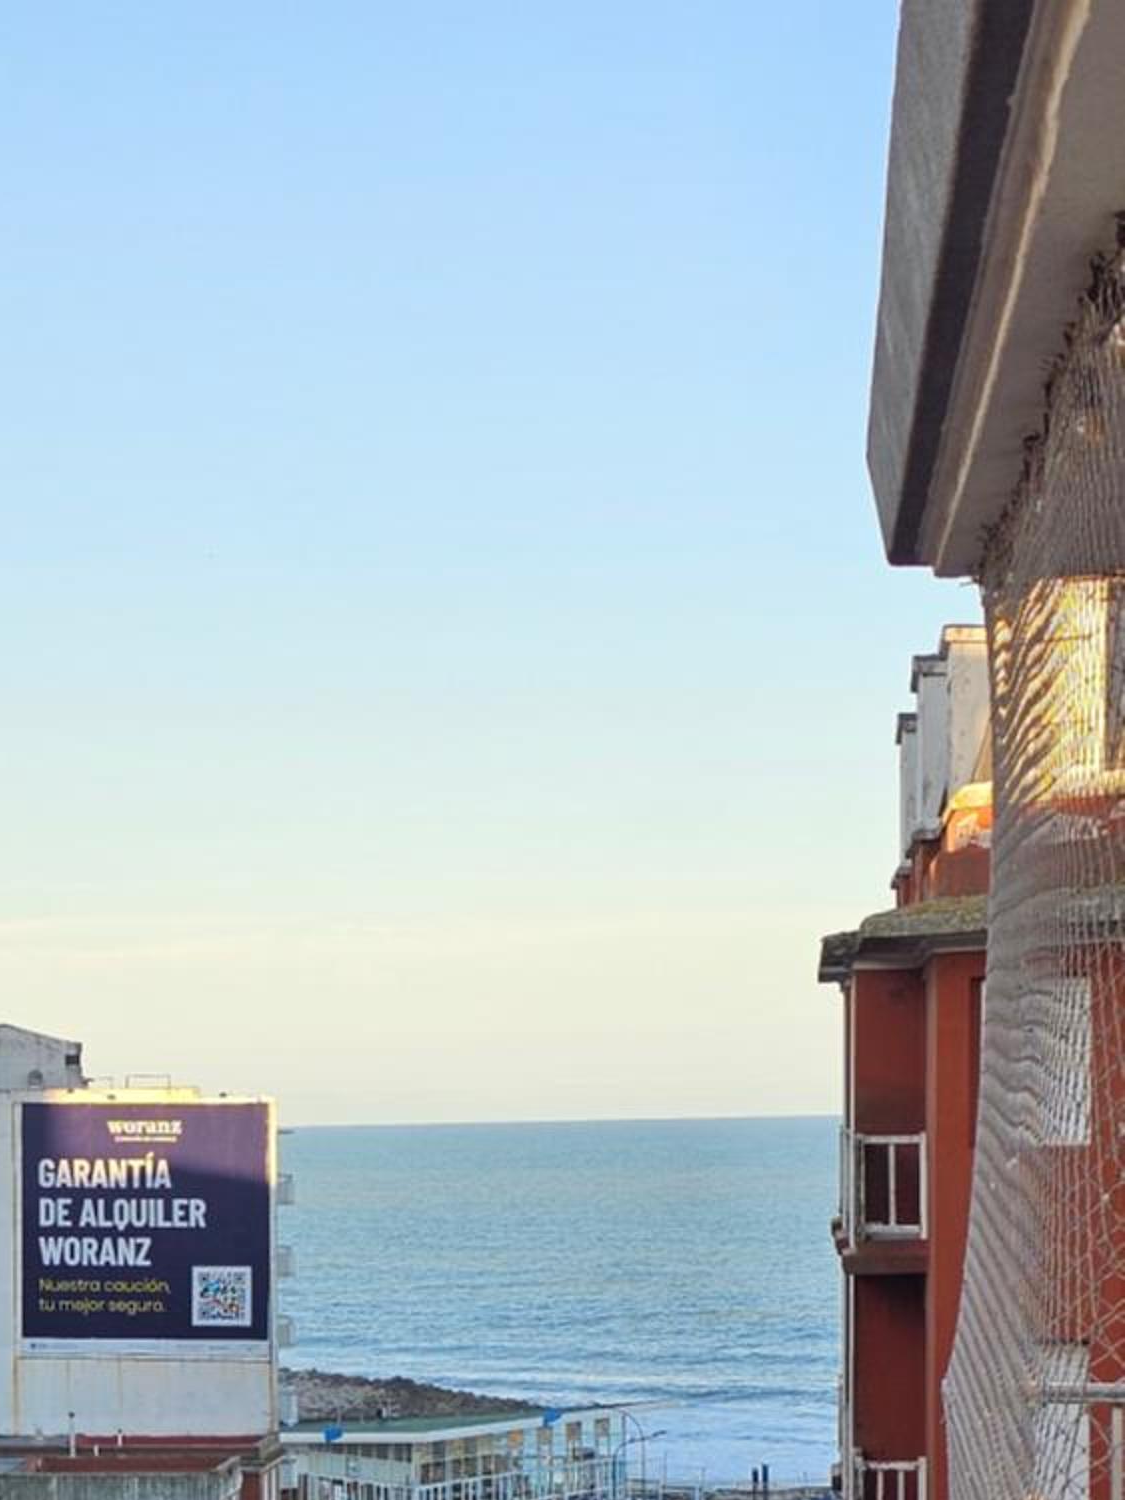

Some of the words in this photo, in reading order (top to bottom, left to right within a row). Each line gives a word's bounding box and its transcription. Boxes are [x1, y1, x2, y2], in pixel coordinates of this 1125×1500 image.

[107, 1120, 182, 1135] woranz
[38, 1151, 172, 1189] GARANTÍA
[39, 1198, 73, 1228] DE
[80, 1198, 206, 1230] ALQUILER
[39, 1237, 152, 1267] WORANZ
[39, 1278, 101, 1292] Nuestra
[39, 1299, 55, 1312] tu
[59, 1298, 104, 1316] mejor
